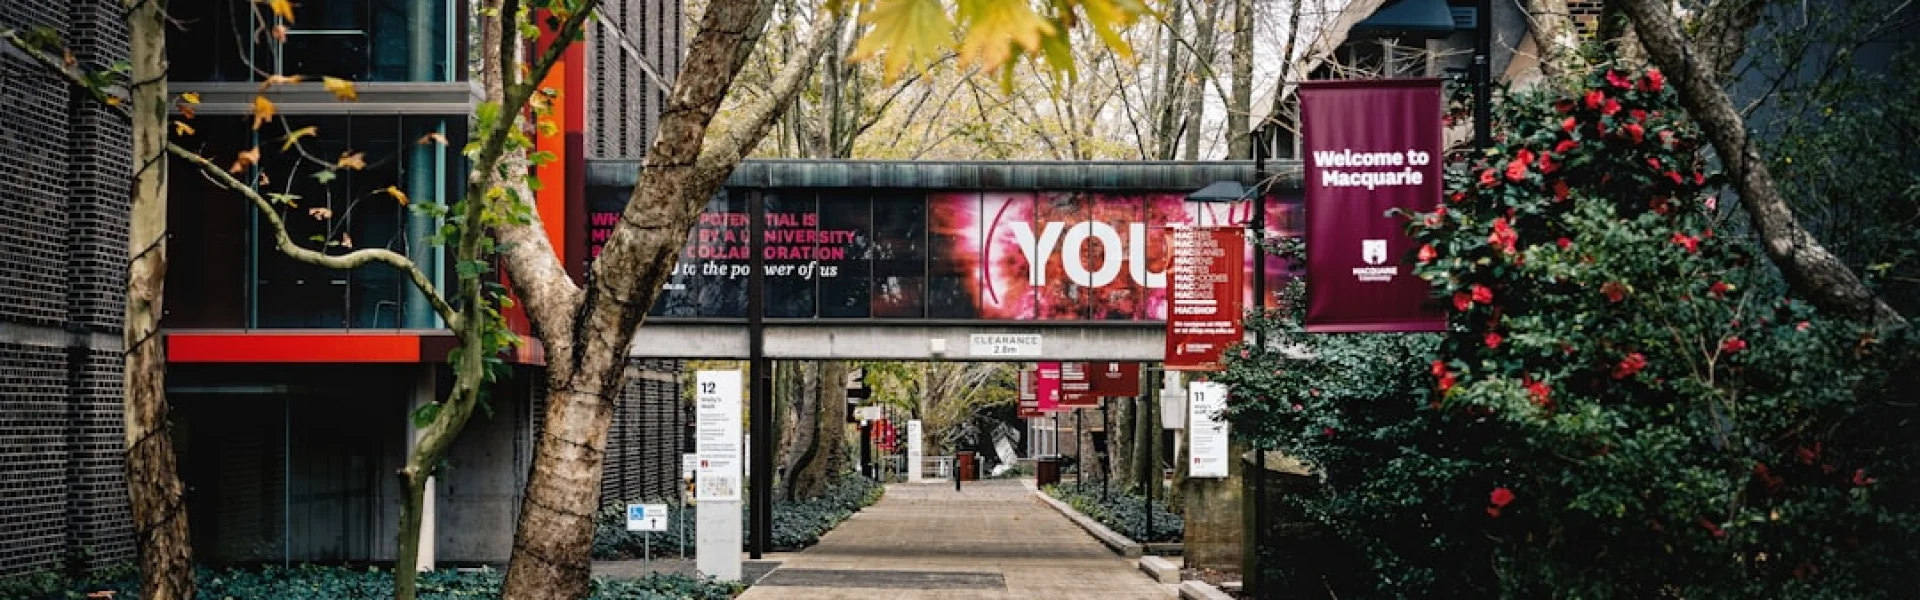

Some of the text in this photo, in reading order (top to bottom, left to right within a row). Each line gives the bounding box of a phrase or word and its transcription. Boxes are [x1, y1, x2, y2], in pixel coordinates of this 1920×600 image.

[1313, 148, 1430, 168] Welcome to
[1322, 166, 1423, 191] Macquarie
[700, 212, 799, 226] POTENTIAL
[803, 212, 817, 226] IS
[699, 229, 855, 244] BY A UNIVERSITY
[687, 246, 845, 260] COLLABORATION
[703, 261, 728, 276] the
[731, 265, 795, 280] power
[798, 261, 817, 280] of
[820, 266, 838, 276] us
[1174, 306, 1217, 315] MACSHOP
[973, 335, 1038, 345] CLEARANCE
[702, 381, 716, 394] 12
[1194, 392, 1204, 401] 11
